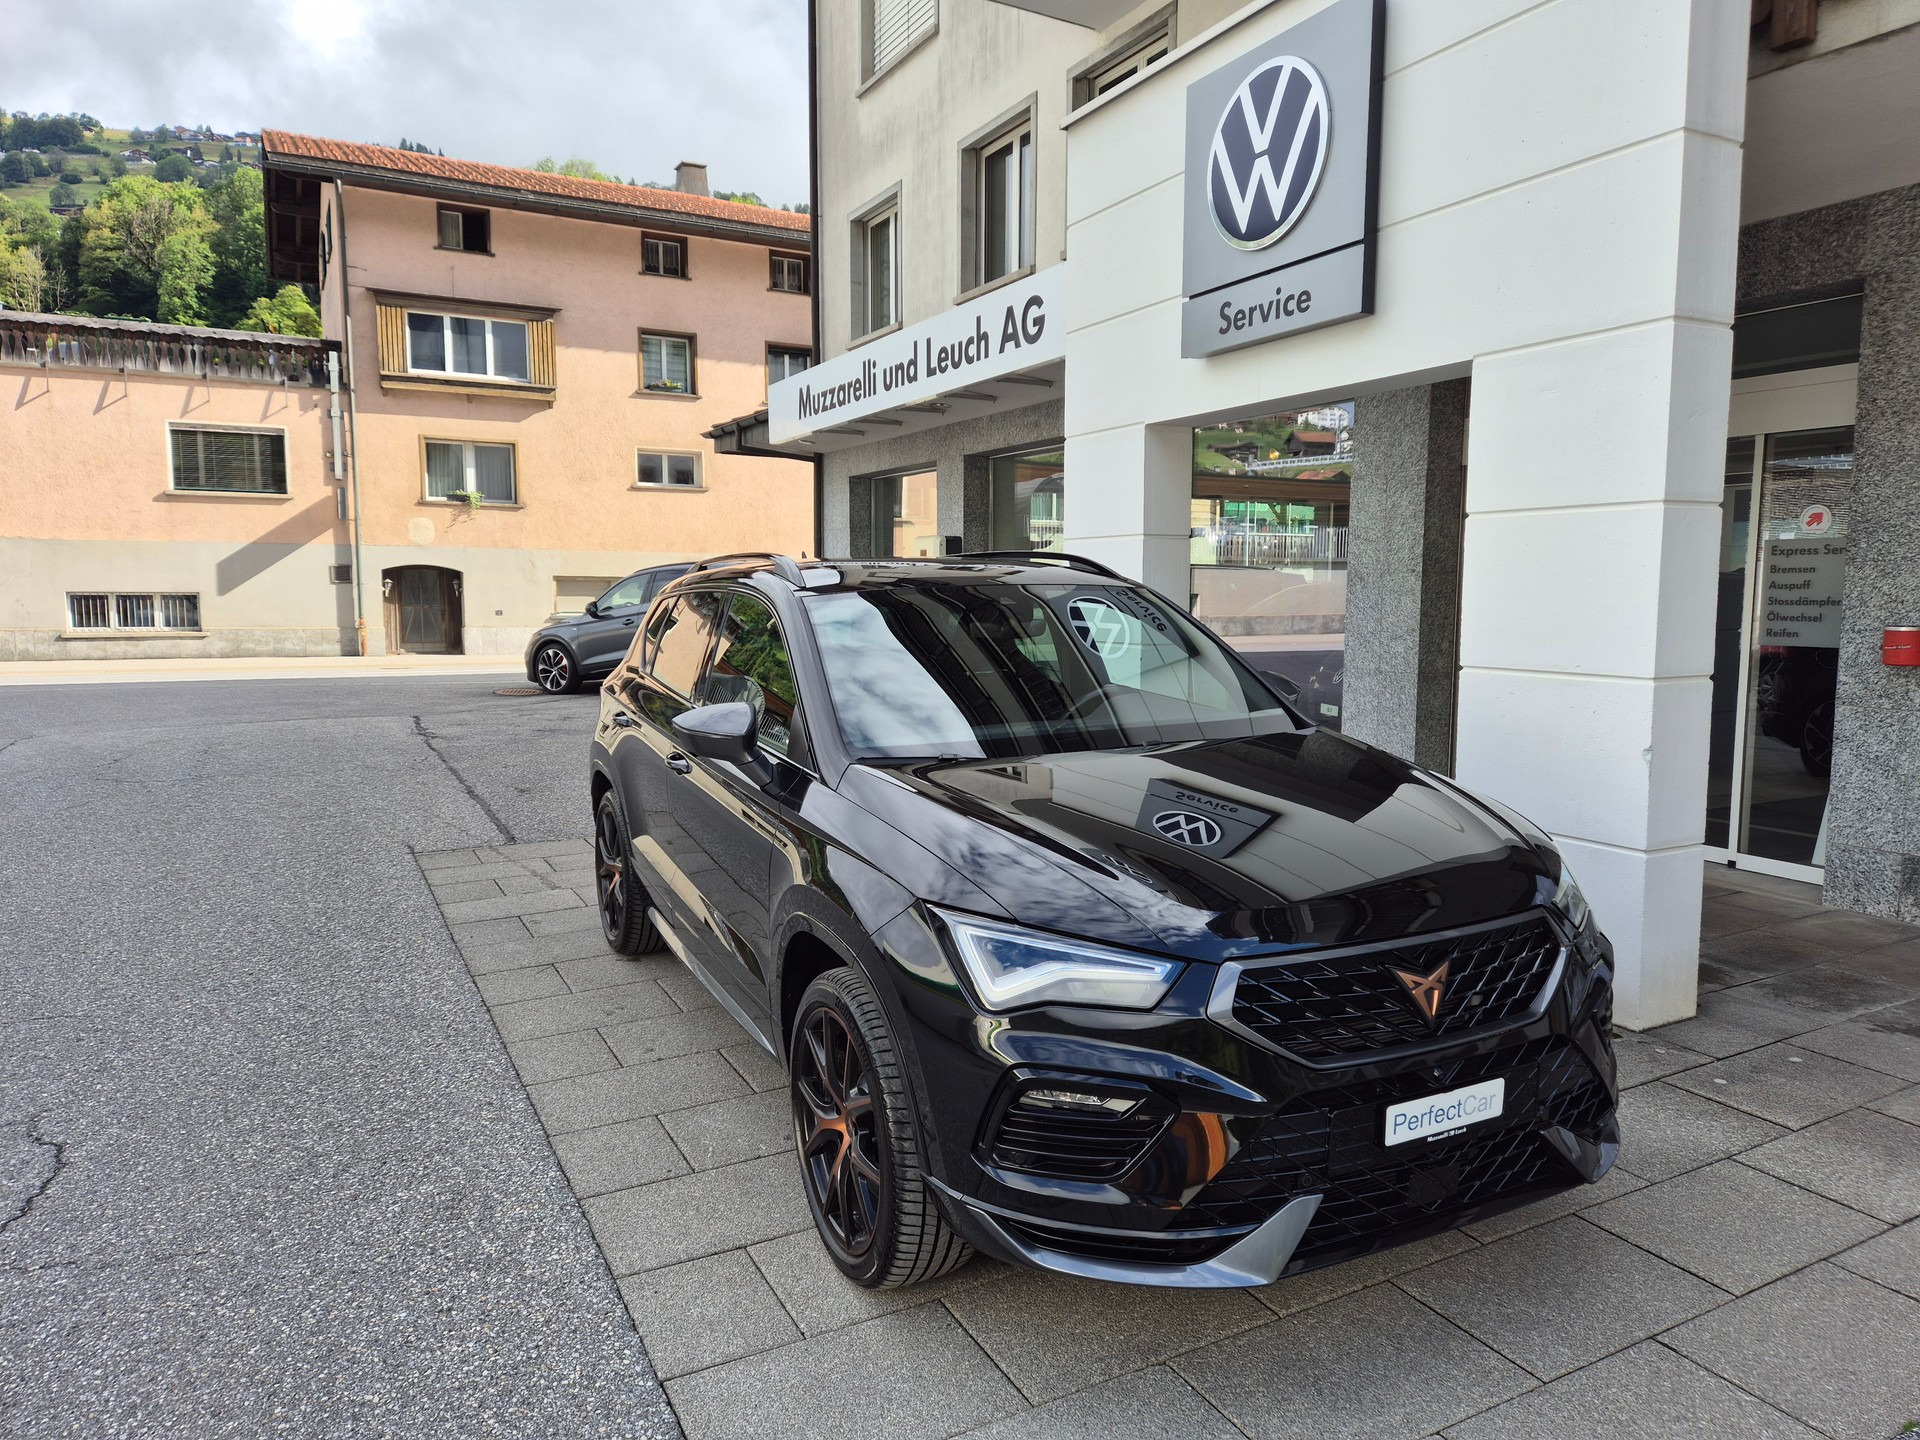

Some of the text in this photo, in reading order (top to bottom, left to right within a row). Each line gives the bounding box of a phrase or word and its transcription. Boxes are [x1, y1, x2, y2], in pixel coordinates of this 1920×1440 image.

[1208, 56, 1330, 250] VW
[1218, 286, 1312, 336] Service
[798, 294, 1046, 420] Muzzarelli und Leuch AG
[1771, 545, 1819, 558] Express
[1770, 564, 1816, 574] Bremsen
[1768, 580, 1812, 592] Auspuff
[1767, 596, 1842, 608] Stossdämpfer
[1766, 610, 1823, 623] Ölwechsel
[1765, 628, 1799, 638] Reifen
[1393, 1093, 1497, 1136] PerfectCar
